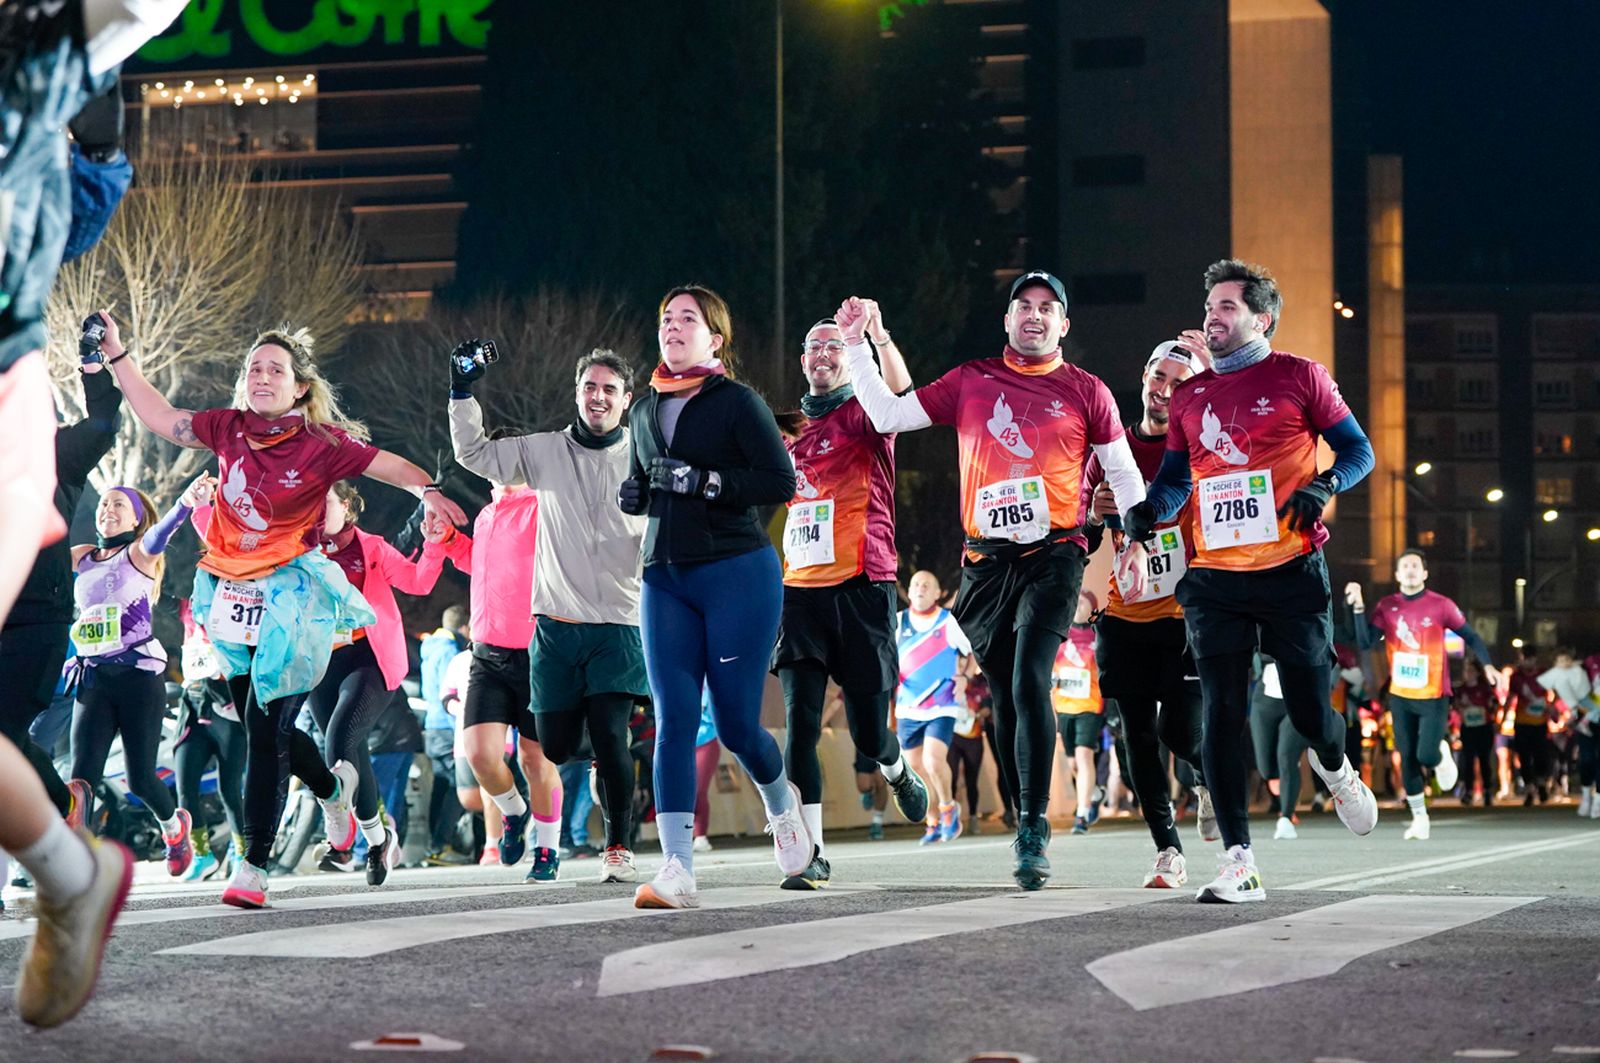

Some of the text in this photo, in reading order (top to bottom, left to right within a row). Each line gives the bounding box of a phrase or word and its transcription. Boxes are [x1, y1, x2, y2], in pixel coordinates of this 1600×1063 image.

[1000, 427, 1019, 447] 43
[1215, 437, 1231, 456] 43
[233, 496, 251, 517] 43
[988, 502, 1034, 529] 2785
[1213, 497, 1259, 523] 2786
[790, 524, 820, 547] 2784
[1147, 553, 1171, 578] 87
[223, 592, 238, 603] SAN
[232, 586, 254, 597] NOCHE
[231, 603, 267, 626] 317
